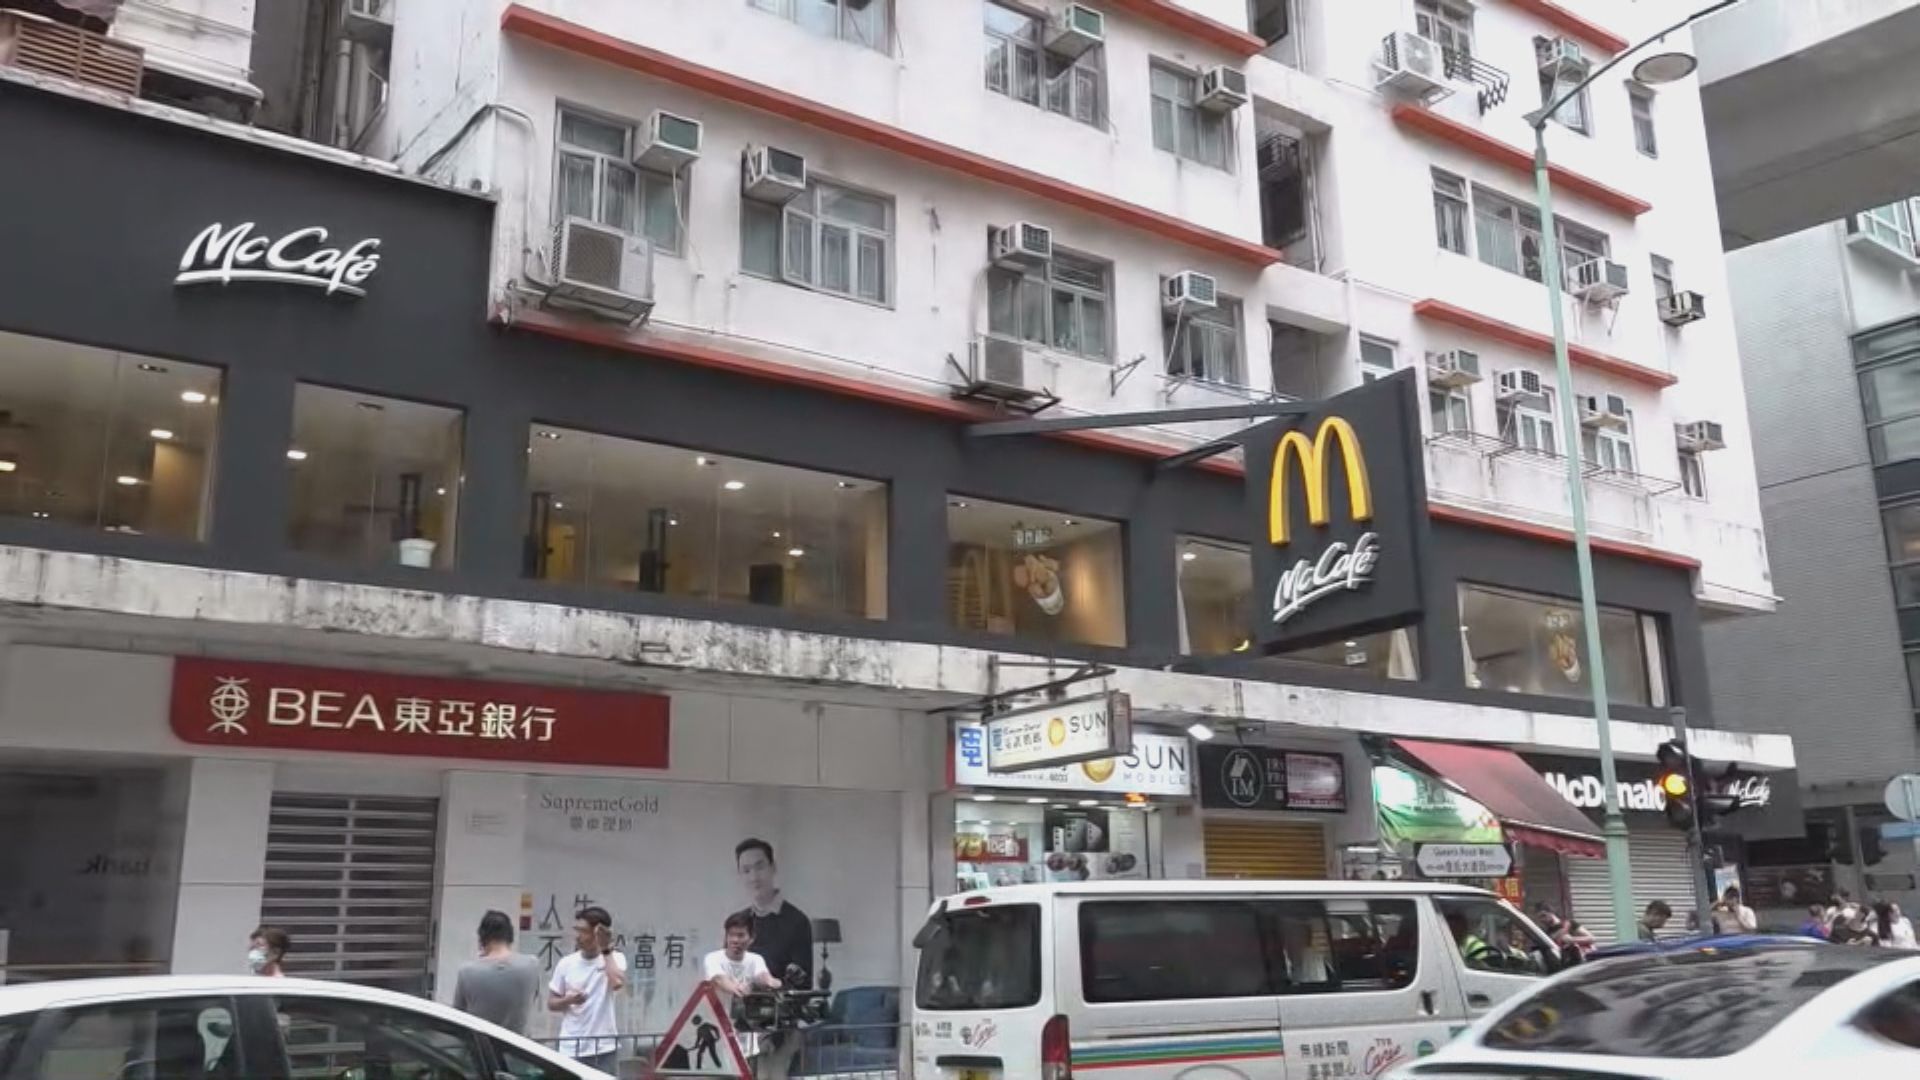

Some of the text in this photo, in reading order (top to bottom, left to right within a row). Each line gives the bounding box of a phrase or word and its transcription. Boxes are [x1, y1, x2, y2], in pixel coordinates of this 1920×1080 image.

[175, 222, 382, 296] McCafé
[1273, 532, 1381, 622] McCafé
[266, 688, 557, 742] BEA 東亞銀行
[1069, 711, 1107, 734] SUN
[1122, 744, 1185, 771] SUN
[1122, 772, 1187, 785] MOBILE
